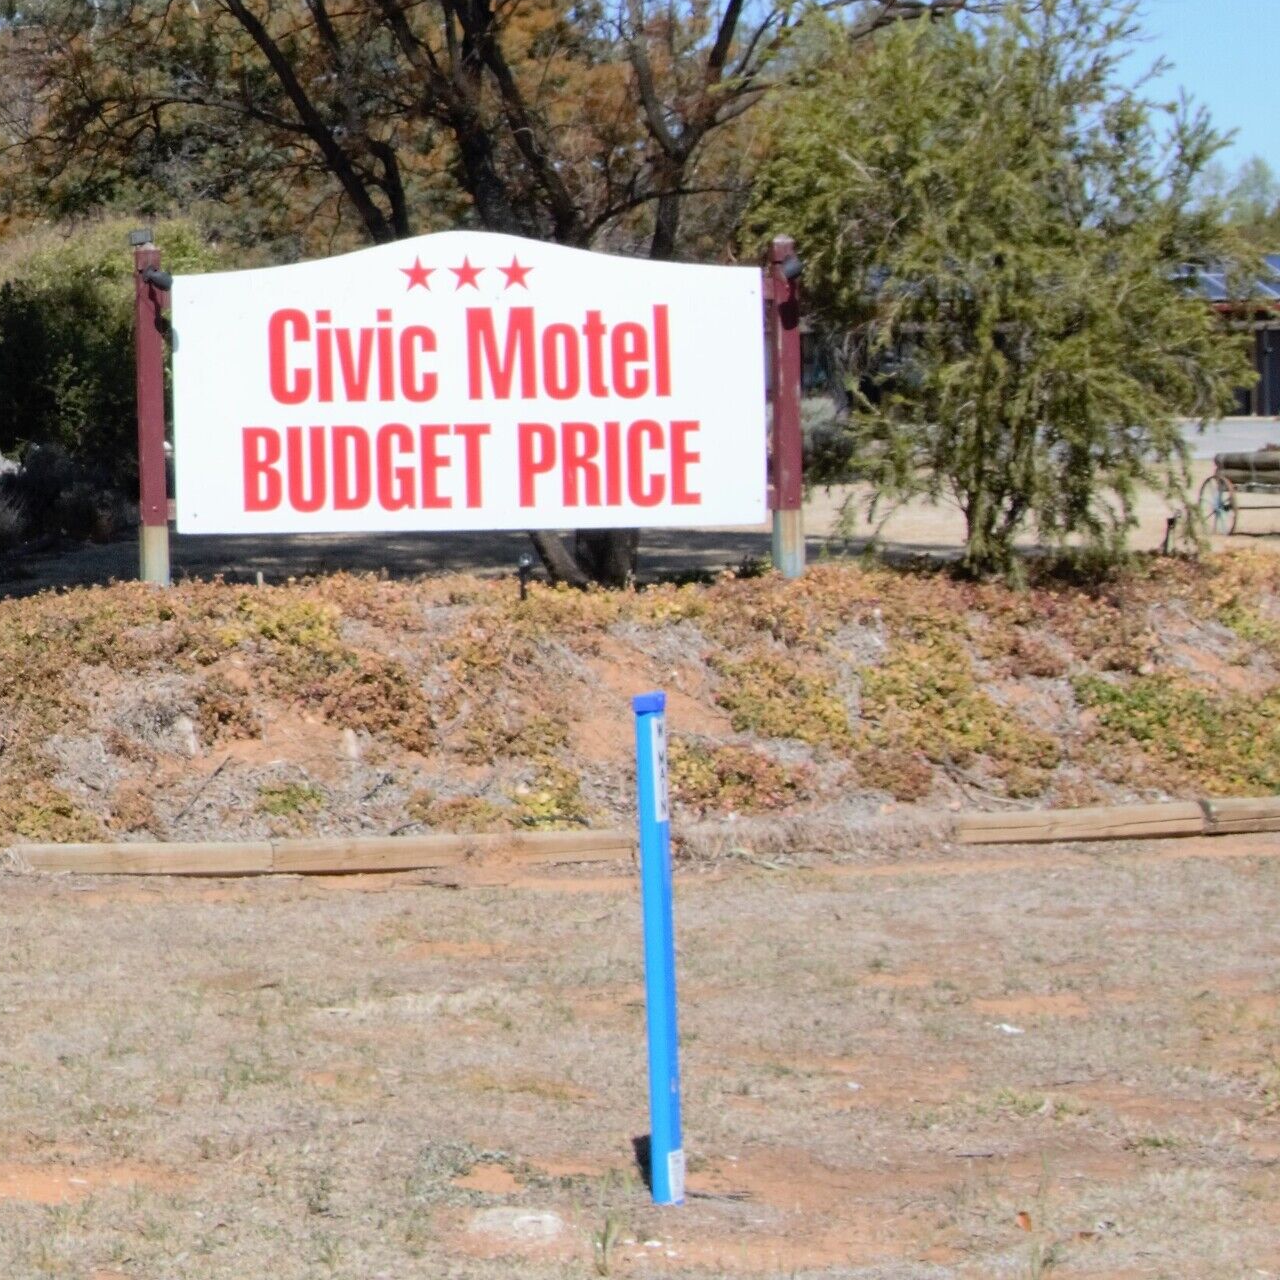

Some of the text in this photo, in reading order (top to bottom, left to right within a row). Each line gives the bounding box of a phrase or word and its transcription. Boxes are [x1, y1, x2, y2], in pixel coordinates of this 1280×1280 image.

[268, 304, 672, 405] Civic Motel
[241, 420, 702, 513] BUDGET PRICE
